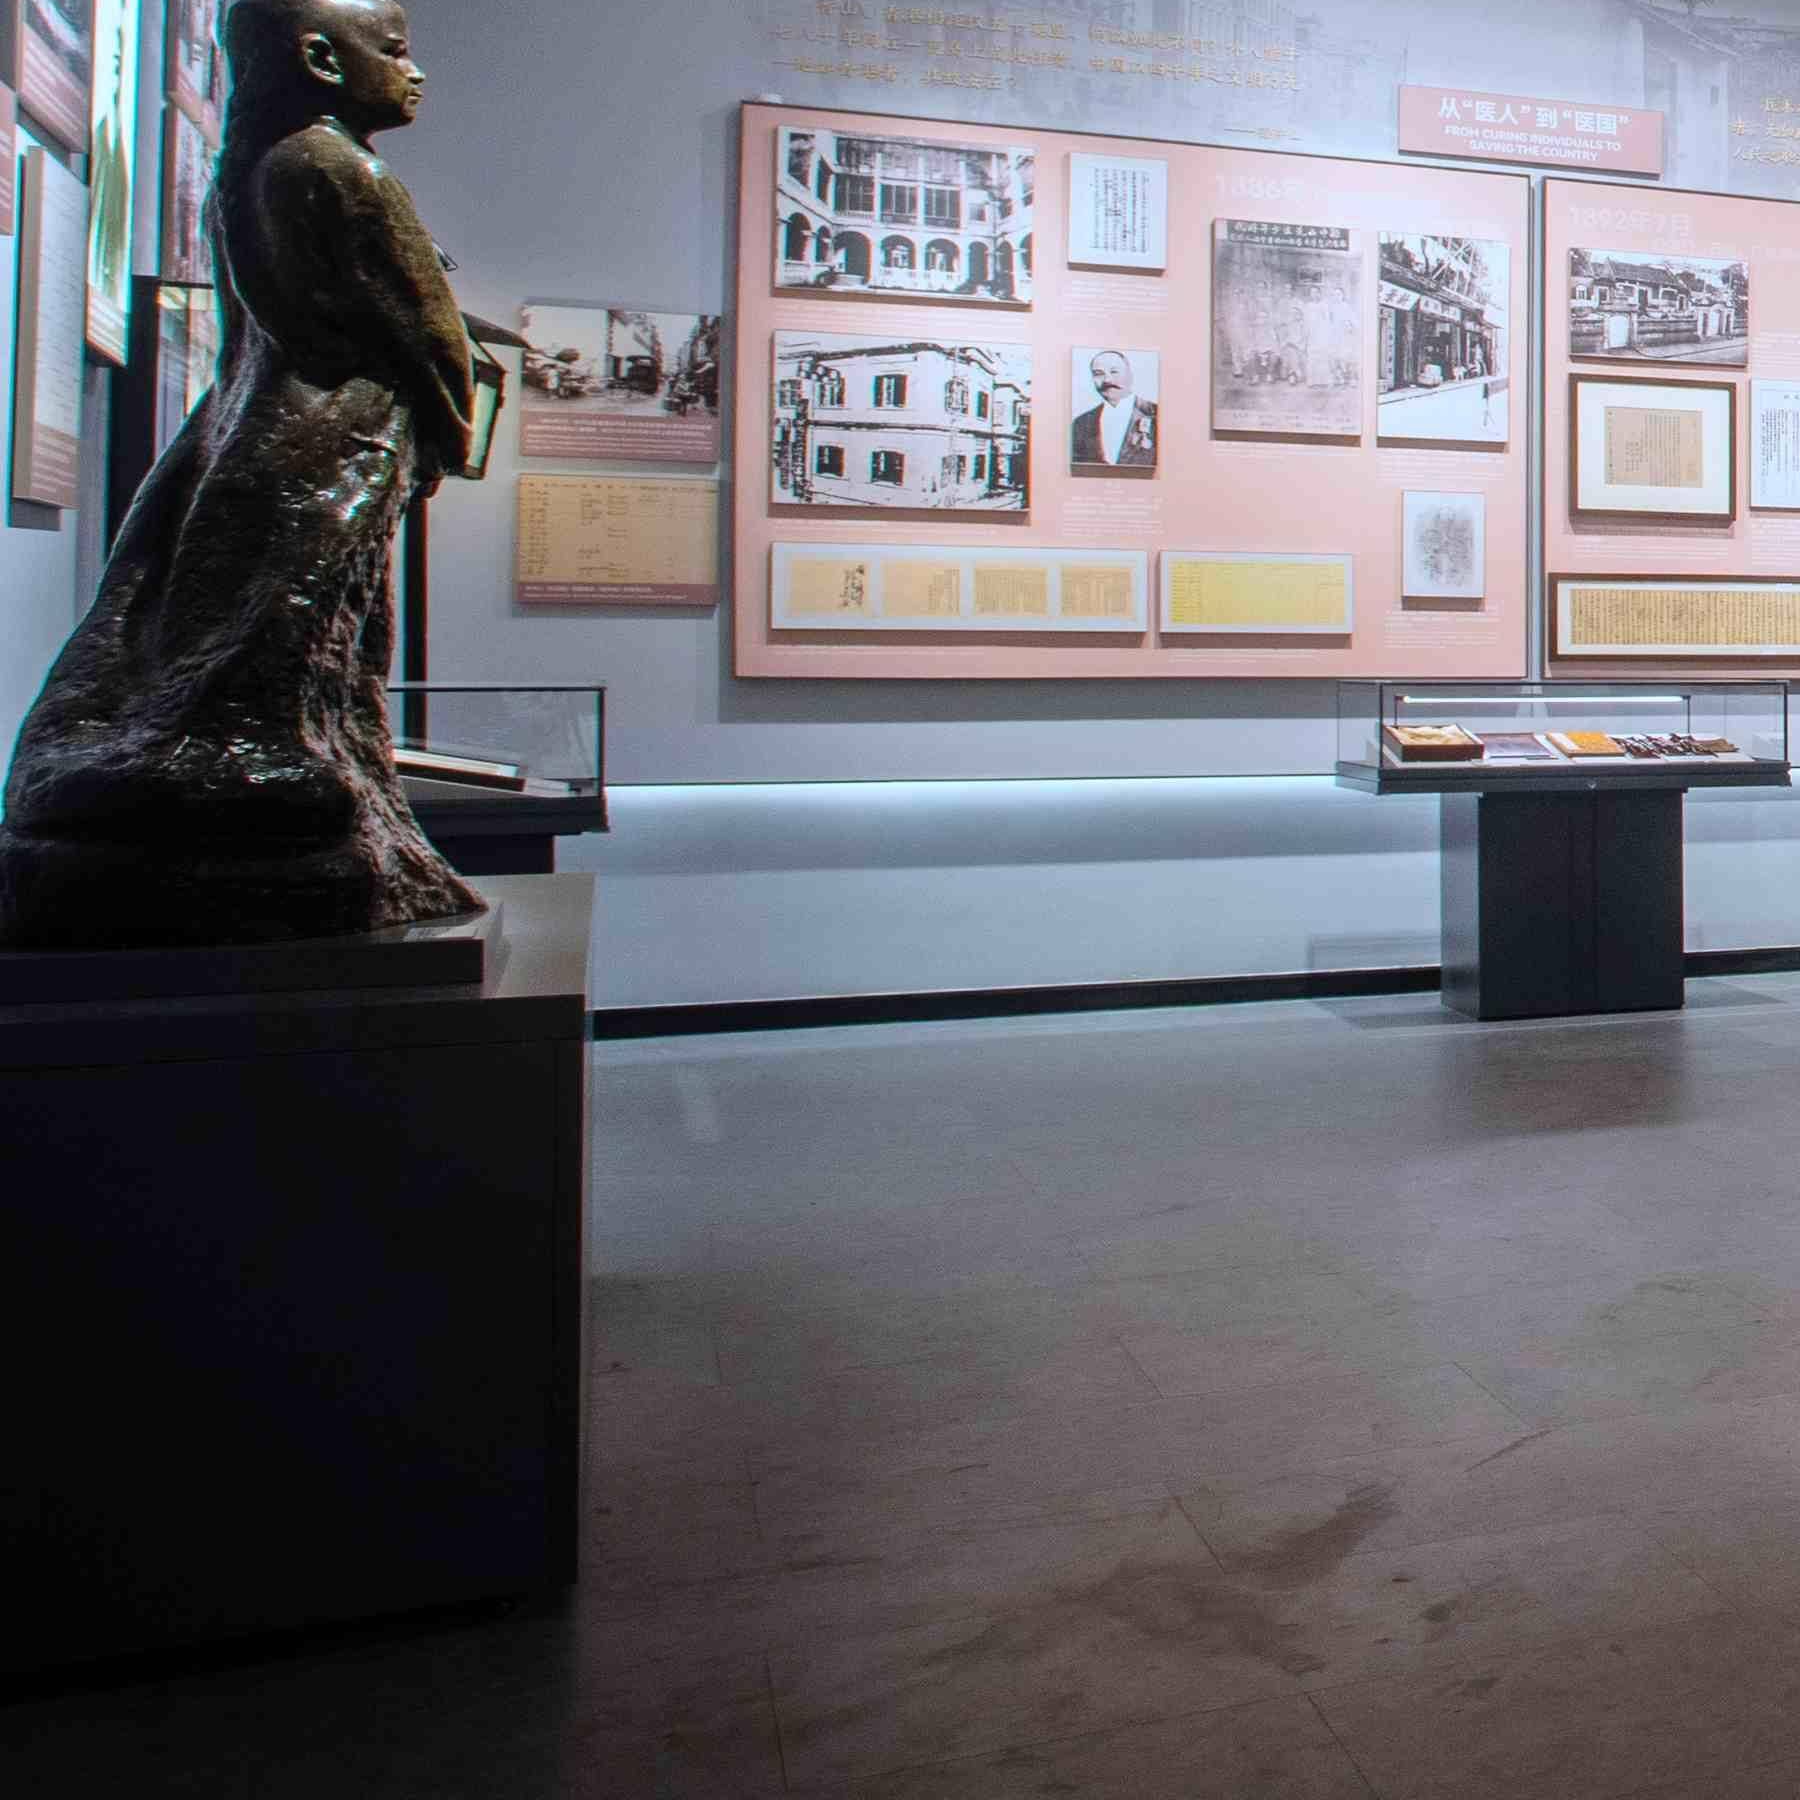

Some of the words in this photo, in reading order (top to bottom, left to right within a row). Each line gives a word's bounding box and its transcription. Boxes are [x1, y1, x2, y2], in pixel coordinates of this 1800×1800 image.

[1437, 95, 1631, 136] 从“医人”到“医国”
[1444, 125, 1482, 138] FROM
[1483, 128, 1528, 142] CURING
[1530, 133, 1605, 150] INDIVIDUALS
[1607, 141, 1622, 152] TO
[1470, 140, 1515, 153] SAVING
[1517, 143, 1541, 157] THE
[1543, 146, 1599, 161] COUNTRY
